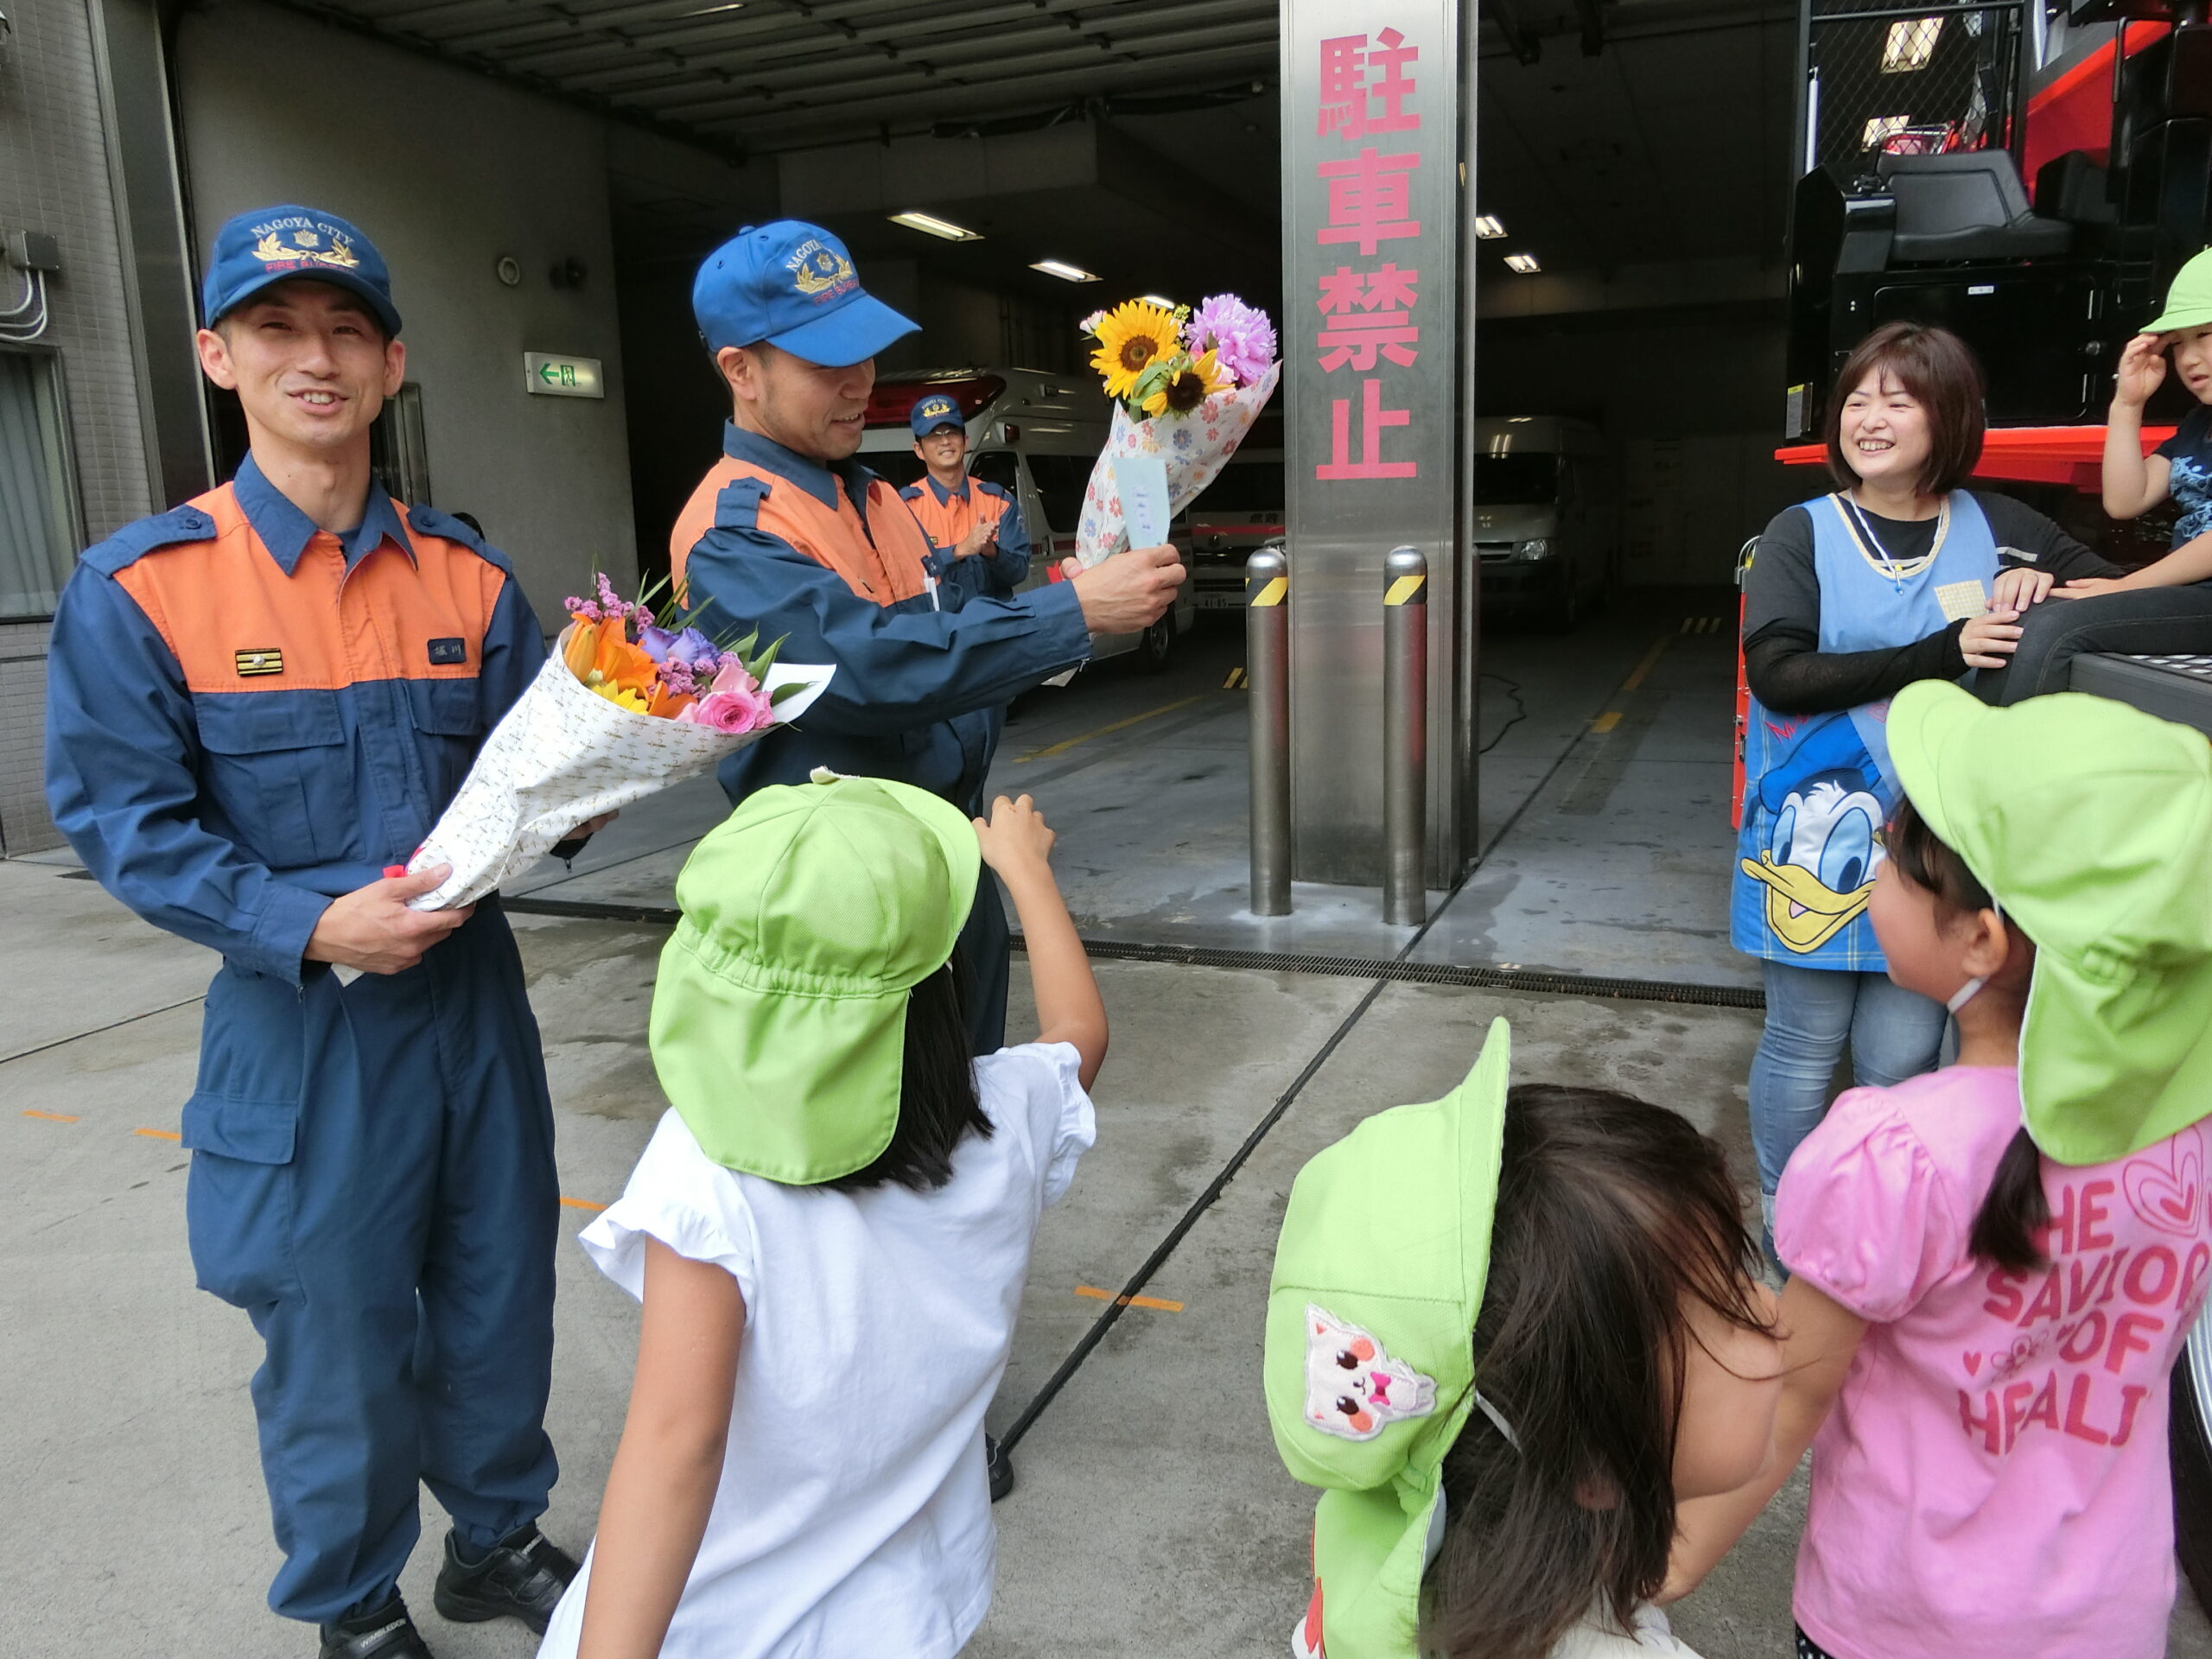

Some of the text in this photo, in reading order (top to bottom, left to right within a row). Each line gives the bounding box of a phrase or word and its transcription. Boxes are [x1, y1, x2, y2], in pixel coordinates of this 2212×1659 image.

[251, 217, 355, 245] NAGOYA CITY
[785, 239, 823, 272] NAGOYA
[1316, 26, 1421, 480] 駐車禁止
[2058, 1310, 2164, 1376] OF
